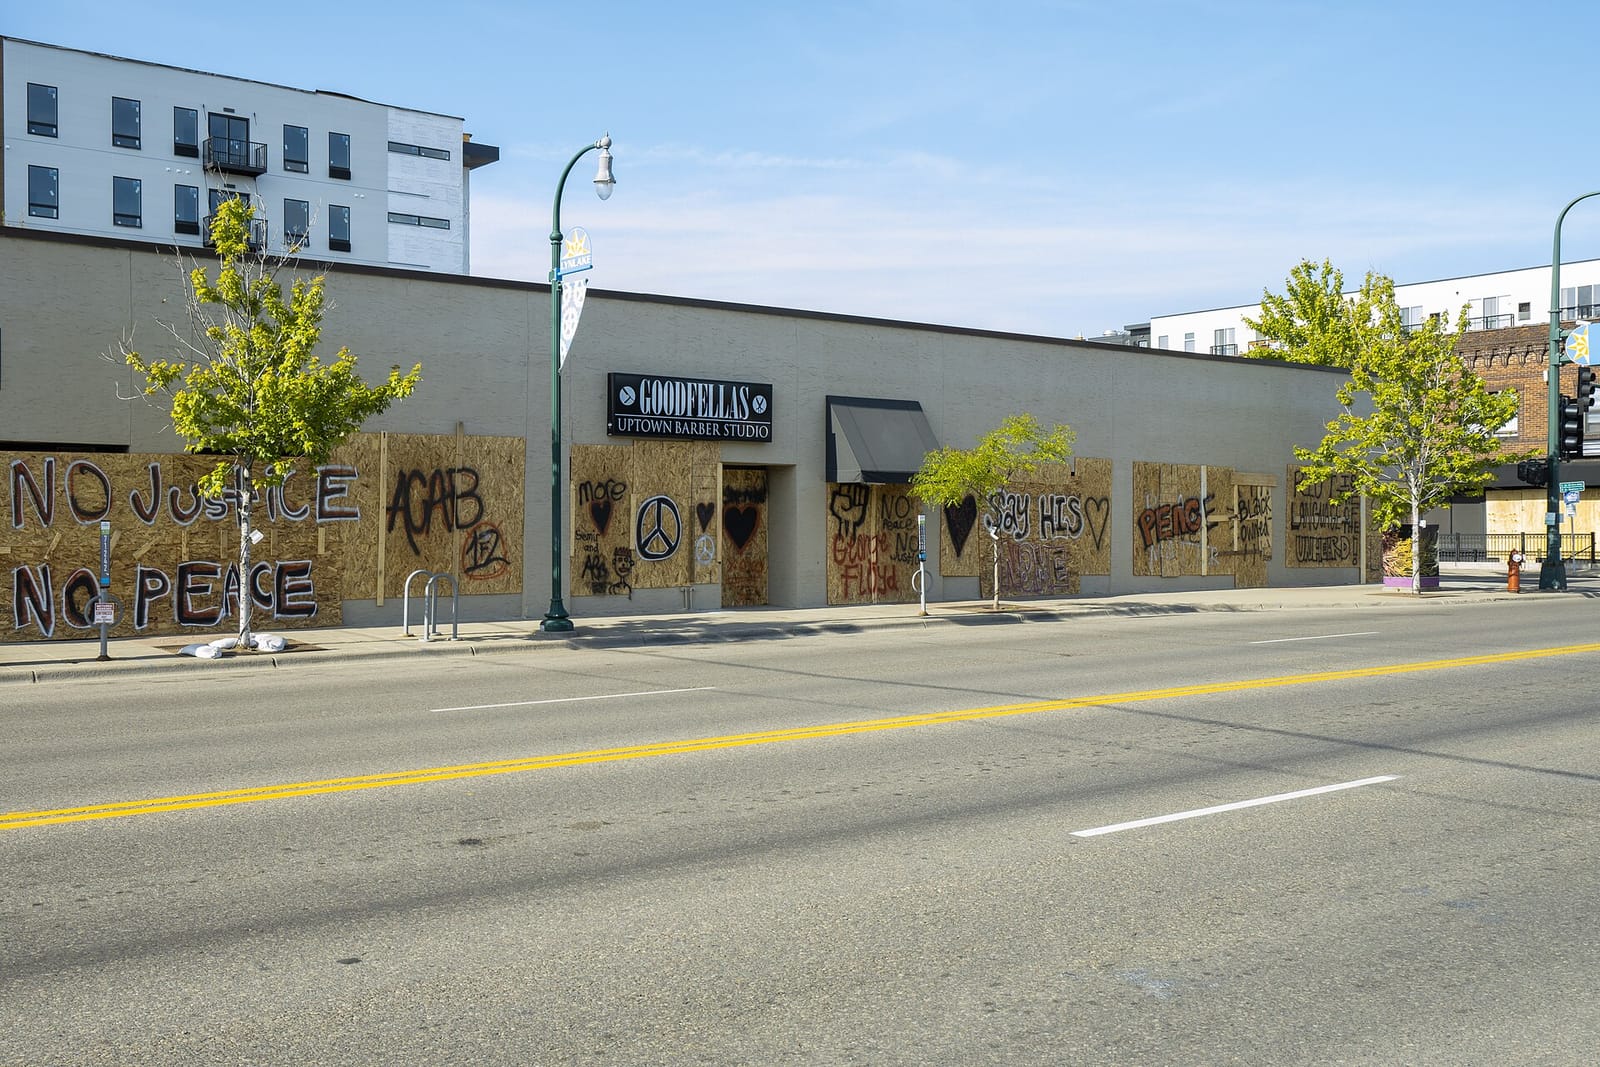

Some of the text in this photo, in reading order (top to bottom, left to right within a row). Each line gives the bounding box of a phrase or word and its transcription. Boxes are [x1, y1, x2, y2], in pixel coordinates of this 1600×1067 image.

[639, 378, 749, 419] GOODFELLAS
[618, 417, 769, 438] UPTOWN BARBER STUDIO
[10, 457, 112, 529] NO
[881, 493, 910, 518] NO
[1039, 493, 1084, 540] HIS
[896, 532, 919, 552] NO
[14, 560, 319, 638] NO PEACE
